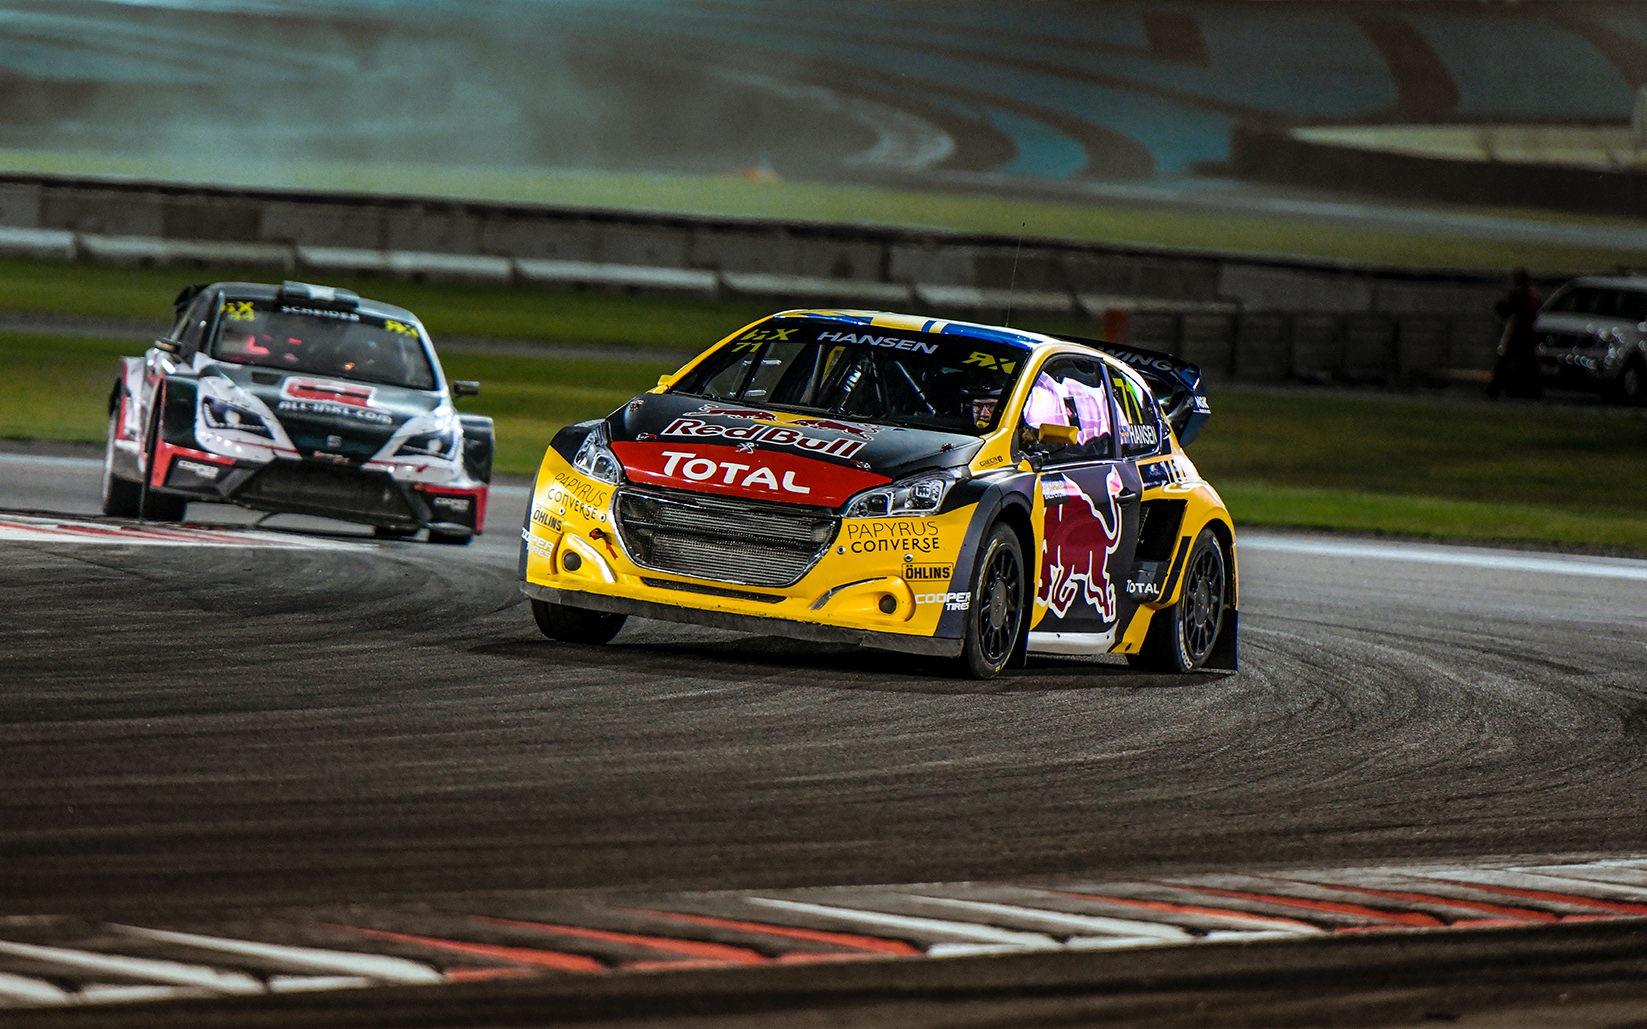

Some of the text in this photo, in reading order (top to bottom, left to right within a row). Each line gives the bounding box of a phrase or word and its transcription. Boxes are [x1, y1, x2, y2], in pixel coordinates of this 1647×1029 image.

[281, 305, 359, 321] SCHEIDER
[731, 342, 764, 353] 71
[817, 331, 938, 354] HANSEN
[1128, 424, 1158, 445] HANSEN
[660, 450, 811, 495] TOTAL
[553, 472, 608, 508] PAPYRUS
[547, 487, 598, 521] CONVERSE
[847, 520, 939, 540] PAPYRUS
[850, 537, 940, 553] CONVERSE
[905, 564, 951, 580] ÖHLINS
[1125, 579, 1160, 595] TOTAL
[914, 591, 971, 605] COOPER
